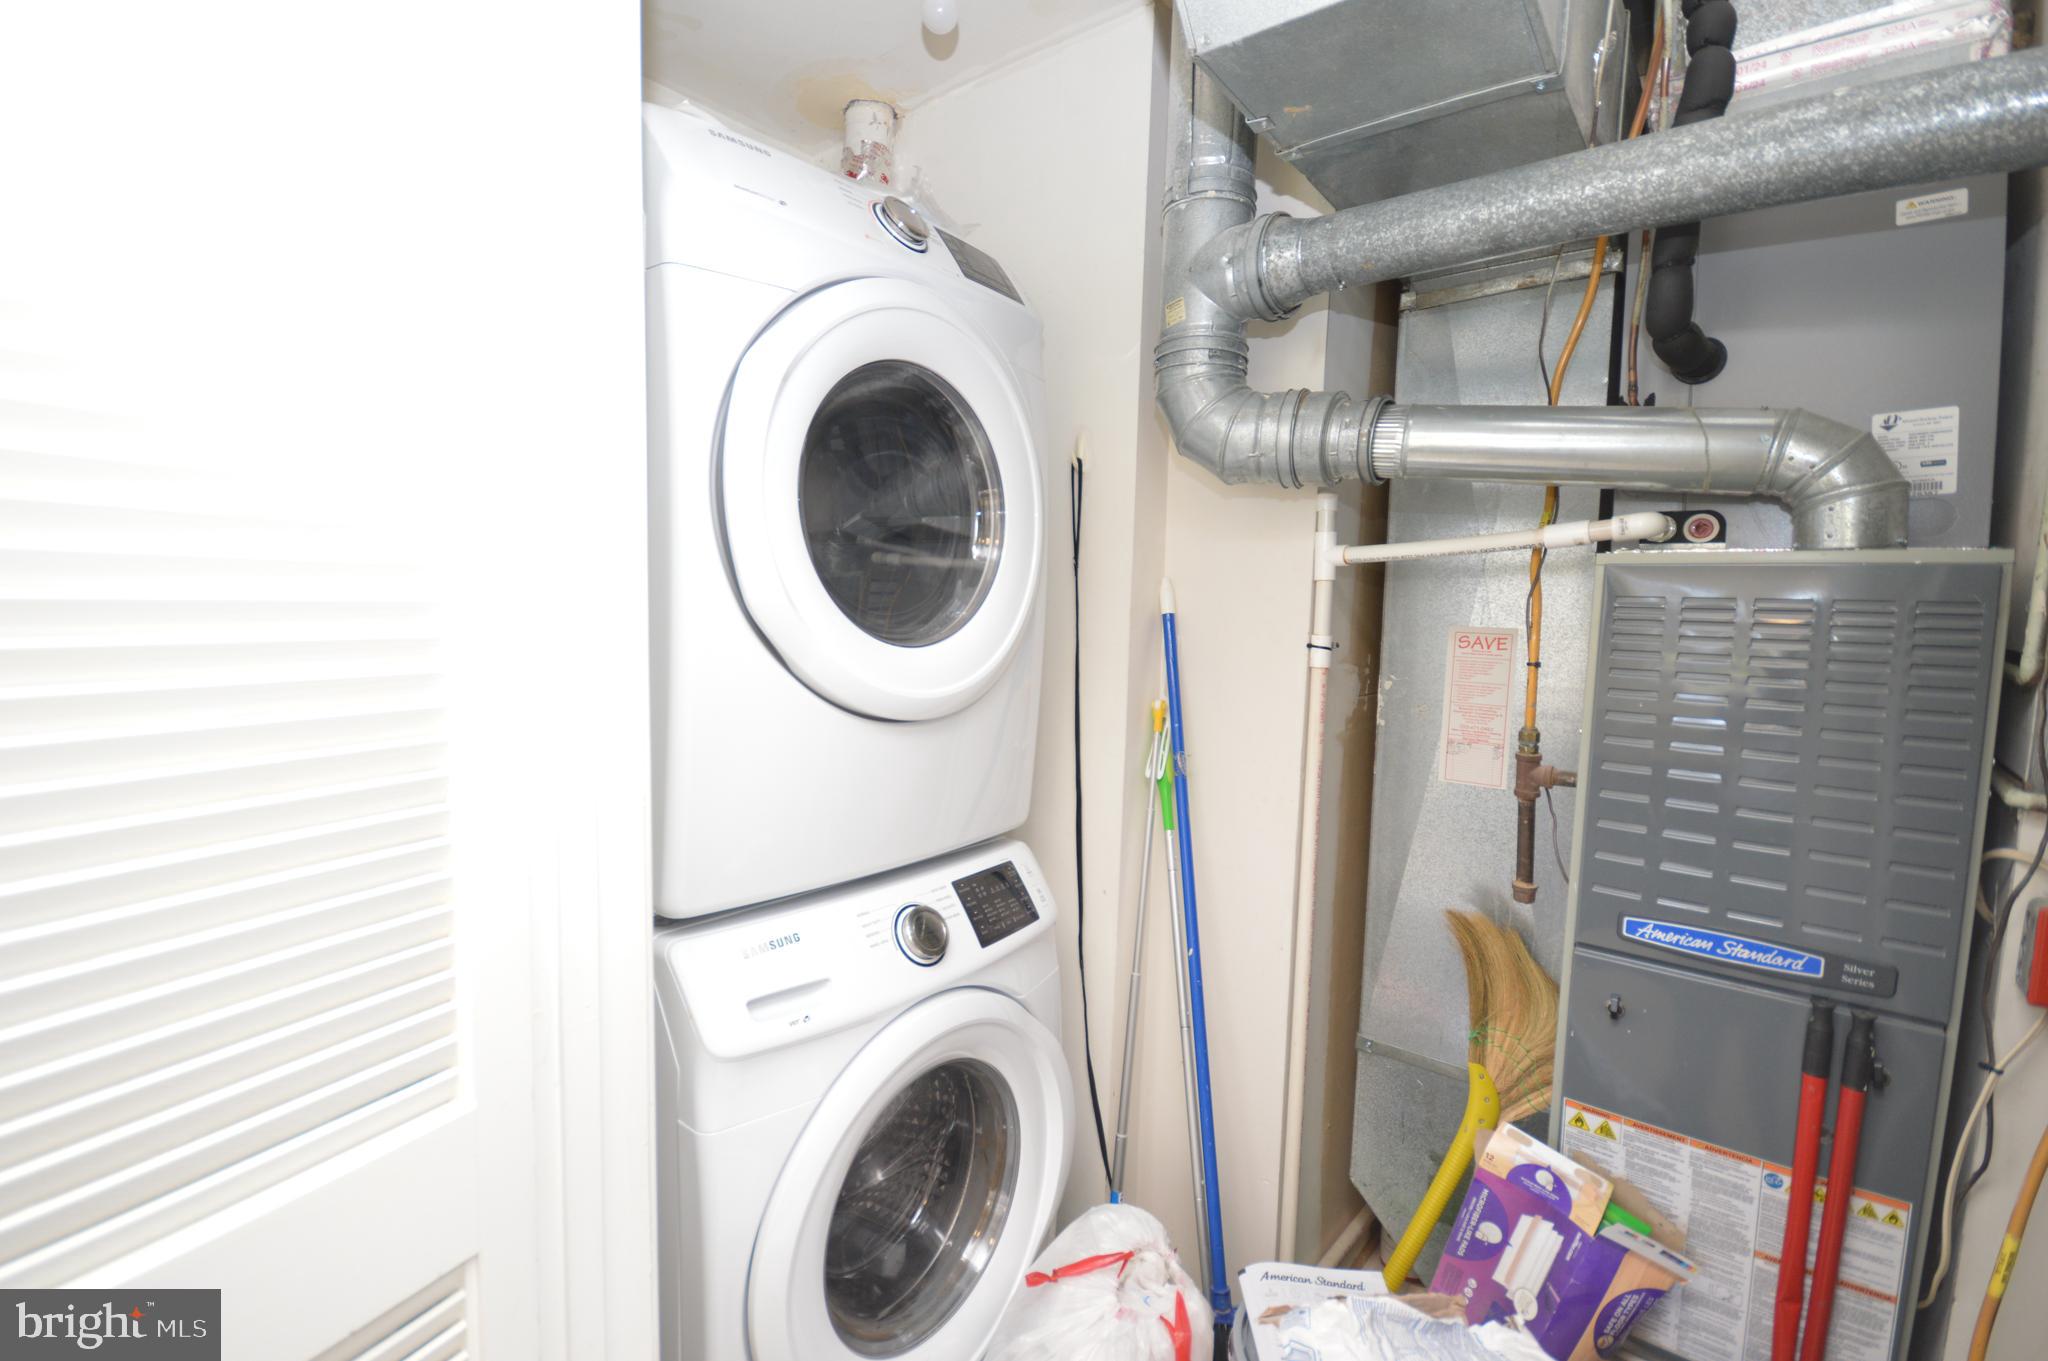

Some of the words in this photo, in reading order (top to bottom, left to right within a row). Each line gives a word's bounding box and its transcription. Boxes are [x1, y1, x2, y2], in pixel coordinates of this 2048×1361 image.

[708, 128, 772, 157] SAMSUNG
[1458, 635, 1509, 651] SAVE
[741, 932, 801, 960] SAMSUNG
[1635, 923, 1712, 951] American
[1717, 940, 1808, 971] Standard
[1843, 962, 1875, 977] Silver
[1841, 974, 1875, 989] Series
[1631, 1121, 1686, 1143] AVERTISSEMENT
[1703, 1143, 1753, 1164] ADVERTENCIA
[1260, 1271, 1312, 1285] American
